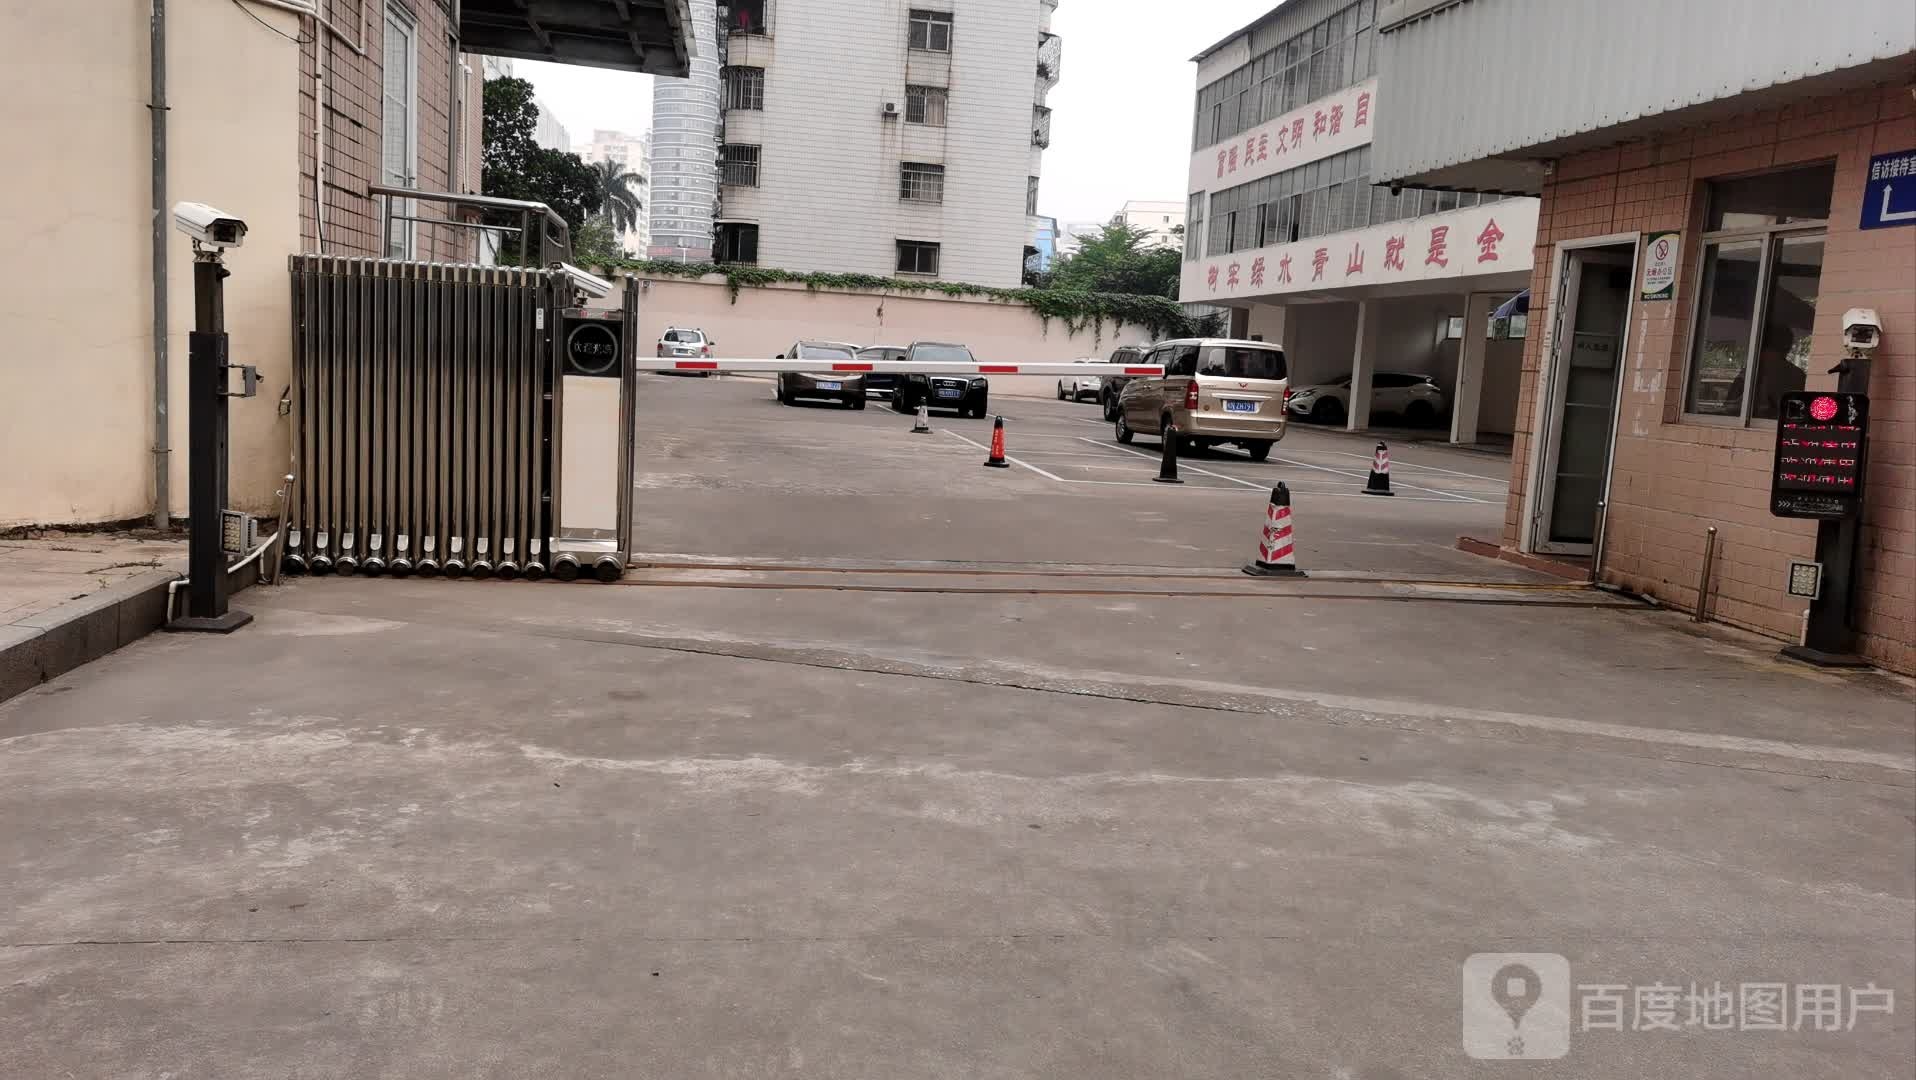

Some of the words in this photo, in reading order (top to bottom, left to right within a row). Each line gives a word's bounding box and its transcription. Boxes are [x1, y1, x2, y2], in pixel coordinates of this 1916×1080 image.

[1207, 218, 1536, 293] 树牢绿水青山就是金
